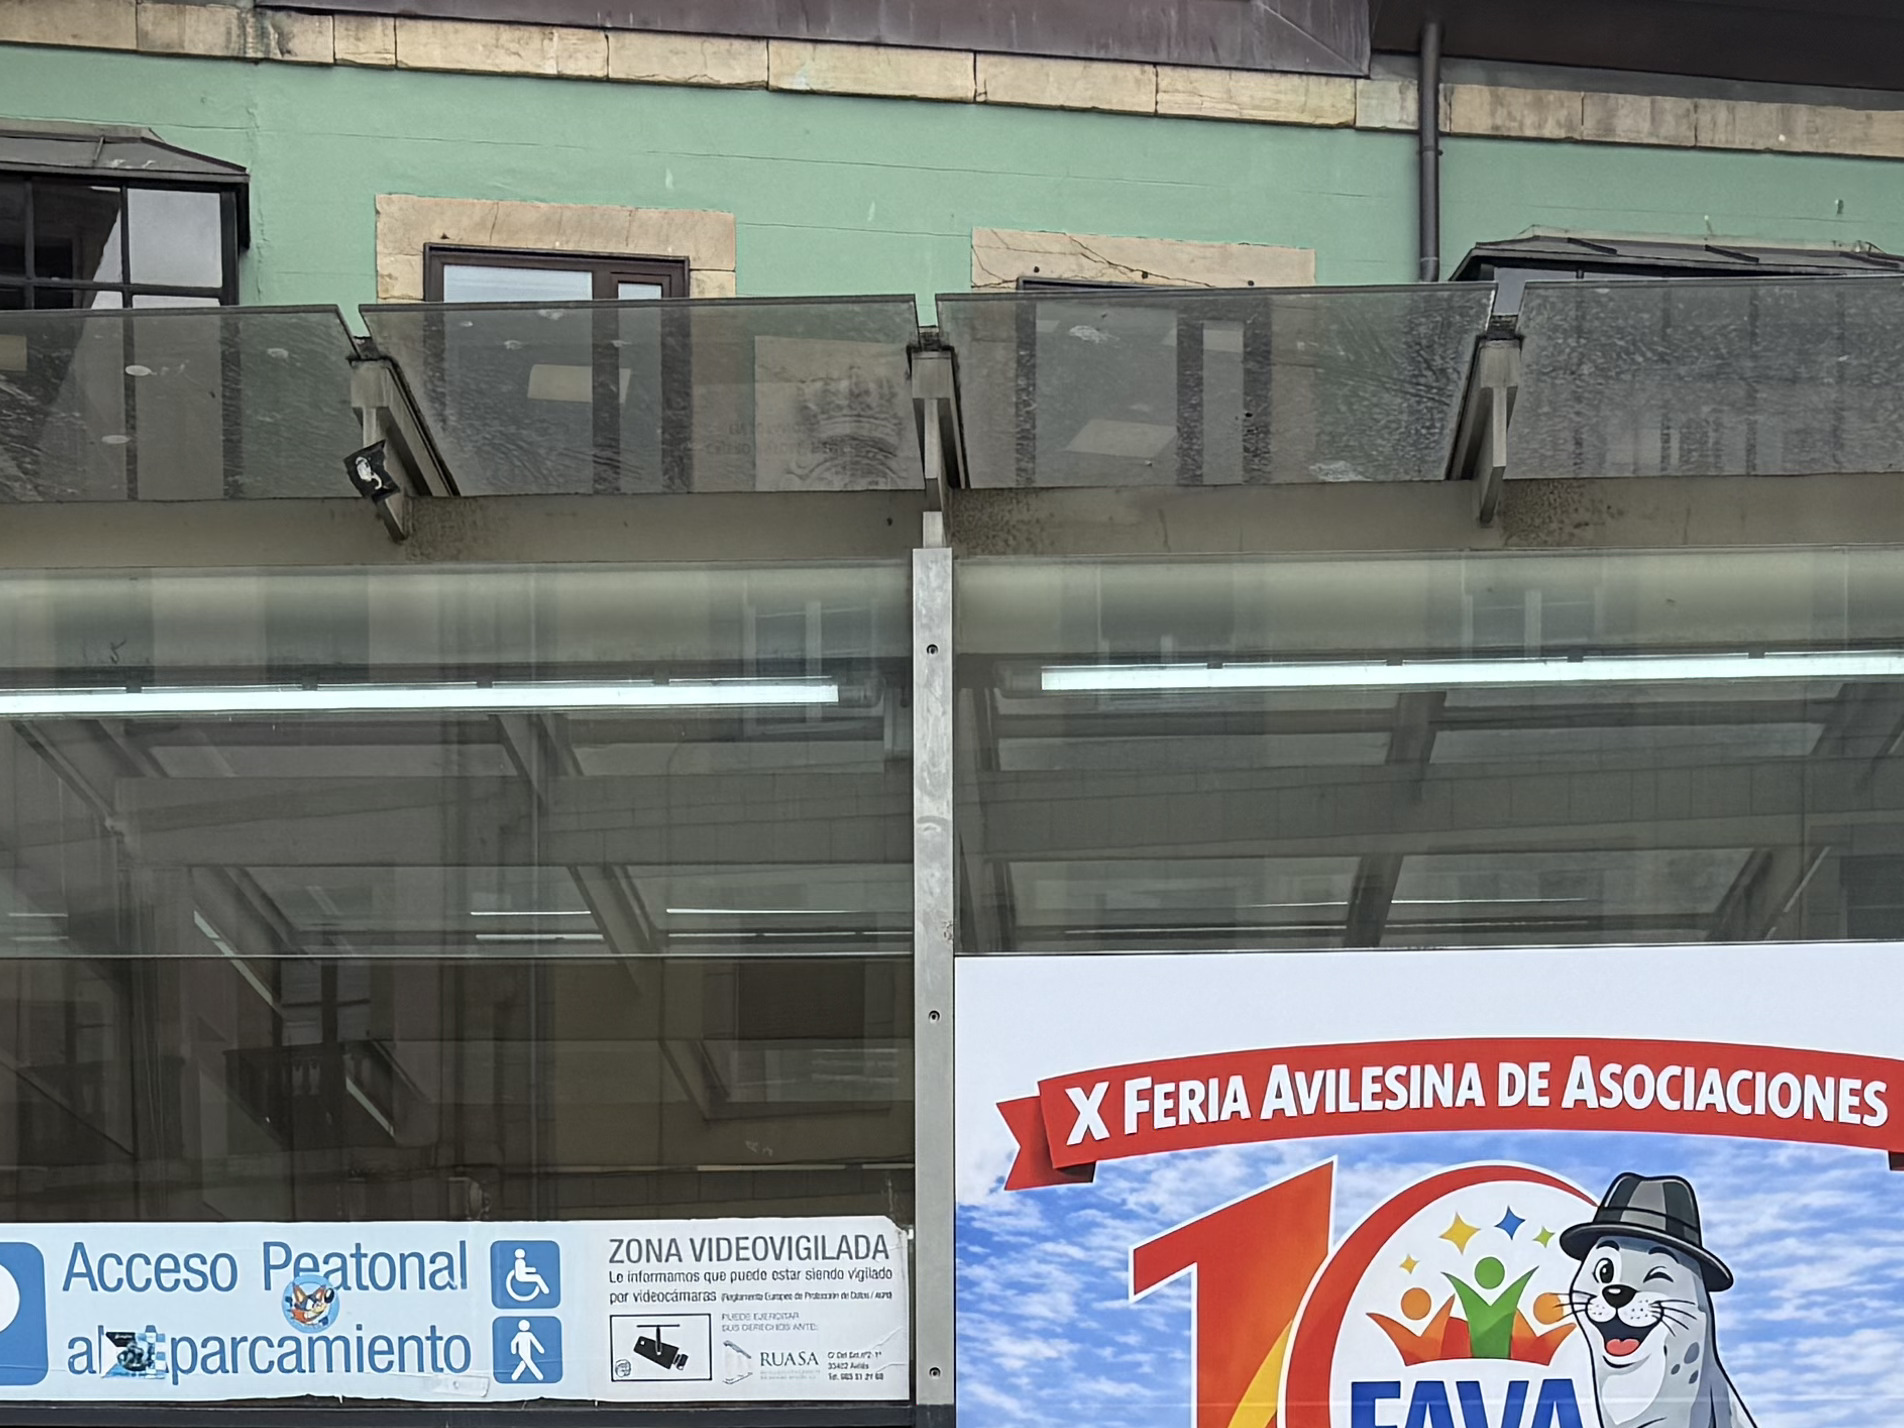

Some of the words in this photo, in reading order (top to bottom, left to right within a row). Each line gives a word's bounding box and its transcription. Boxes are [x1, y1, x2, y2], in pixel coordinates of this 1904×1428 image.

[1065, 1081, 1111, 1146] X
[1498, 1061, 1552, 1108] DE
[608, 1237, 683, 1263] ZONA
[689, 1234, 890, 1262] VIDEOVIGILADA
[62, 1240, 239, 1293] Acceso
[262, 1239, 469, 1293] Peatonal
[627, 1270, 701, 1284] informamos
[703, 1270, 727, 1285] que
[729, 1268, 767, 1285] puede
[805, 1267, 844, 1281] siendo
[848, 1266, 893, 1283] vigilado
[609, 1292, 629, 1305] por
[633, 1289, 717, 1303] videocámaras
[142, 1324, 472, 1386] parcamiento
[760, 1351, 819, 1367] RUASA
